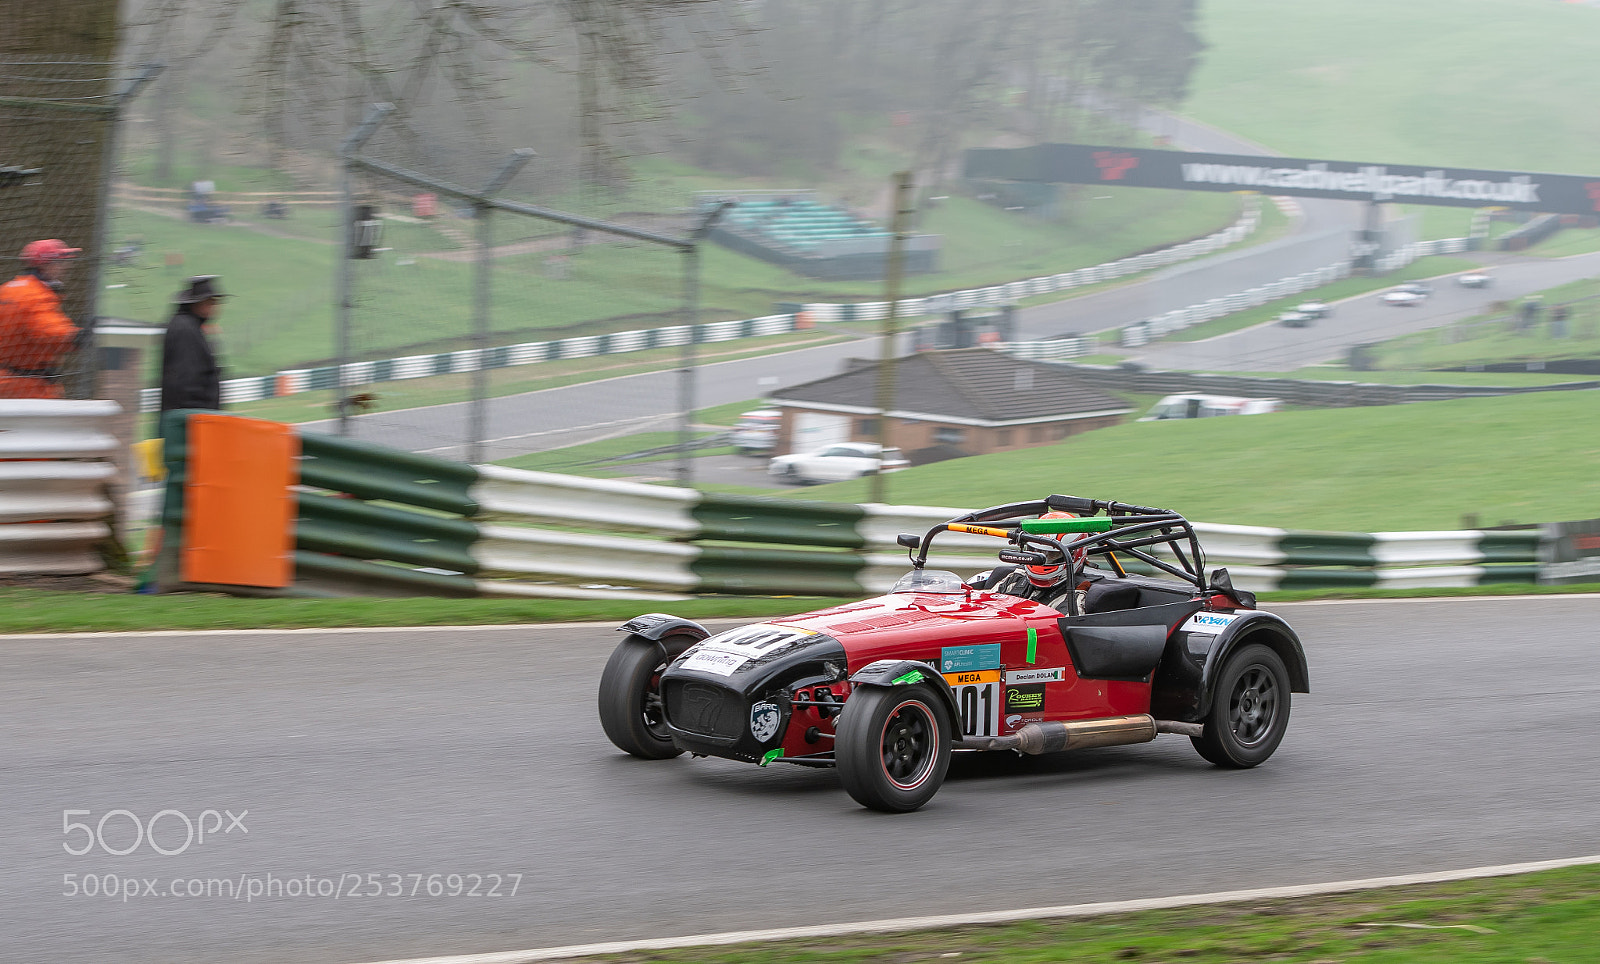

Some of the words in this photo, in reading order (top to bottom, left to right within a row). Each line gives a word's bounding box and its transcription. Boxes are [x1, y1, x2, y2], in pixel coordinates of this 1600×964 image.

[966, 526, 989, 535] MEGA
[720, 629, 796, 650] 101
[957, 673, 982, 683] MEGA
[1036, 671, 1055, 679] DOLAN
[754, 703, 778, 713] BARC
